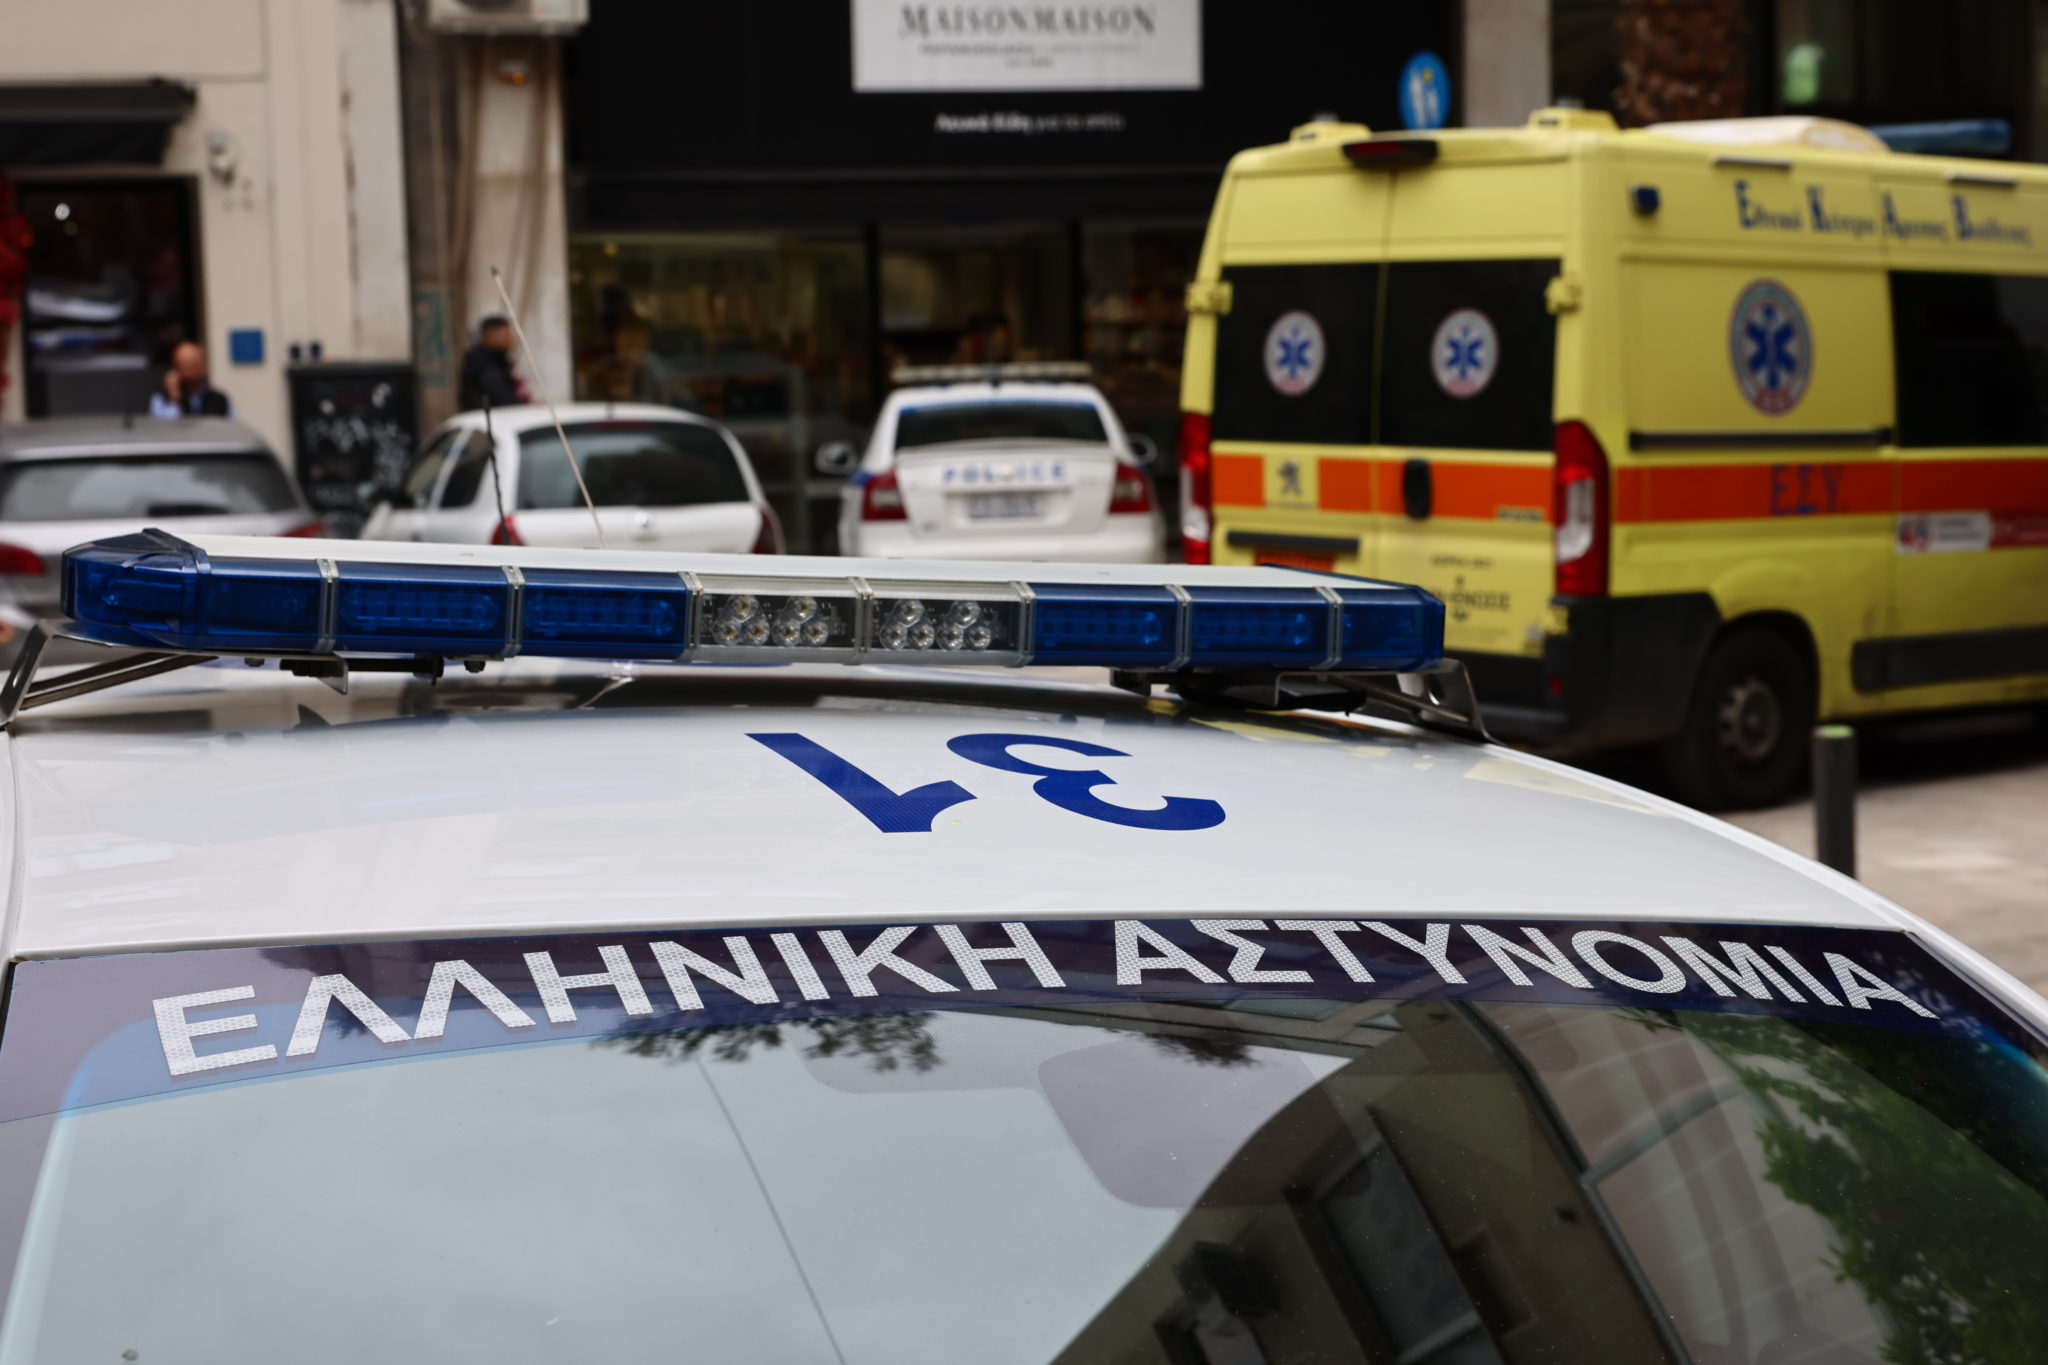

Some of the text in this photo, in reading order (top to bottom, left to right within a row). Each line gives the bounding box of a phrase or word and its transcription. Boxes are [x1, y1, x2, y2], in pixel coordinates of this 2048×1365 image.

[943, 461, 1066, 483] POLICE
[153, 919, 1939, 1077] ΕΛΛΗΝΙΚΗ ΑΣΤΥΝΟΜΙΑ
